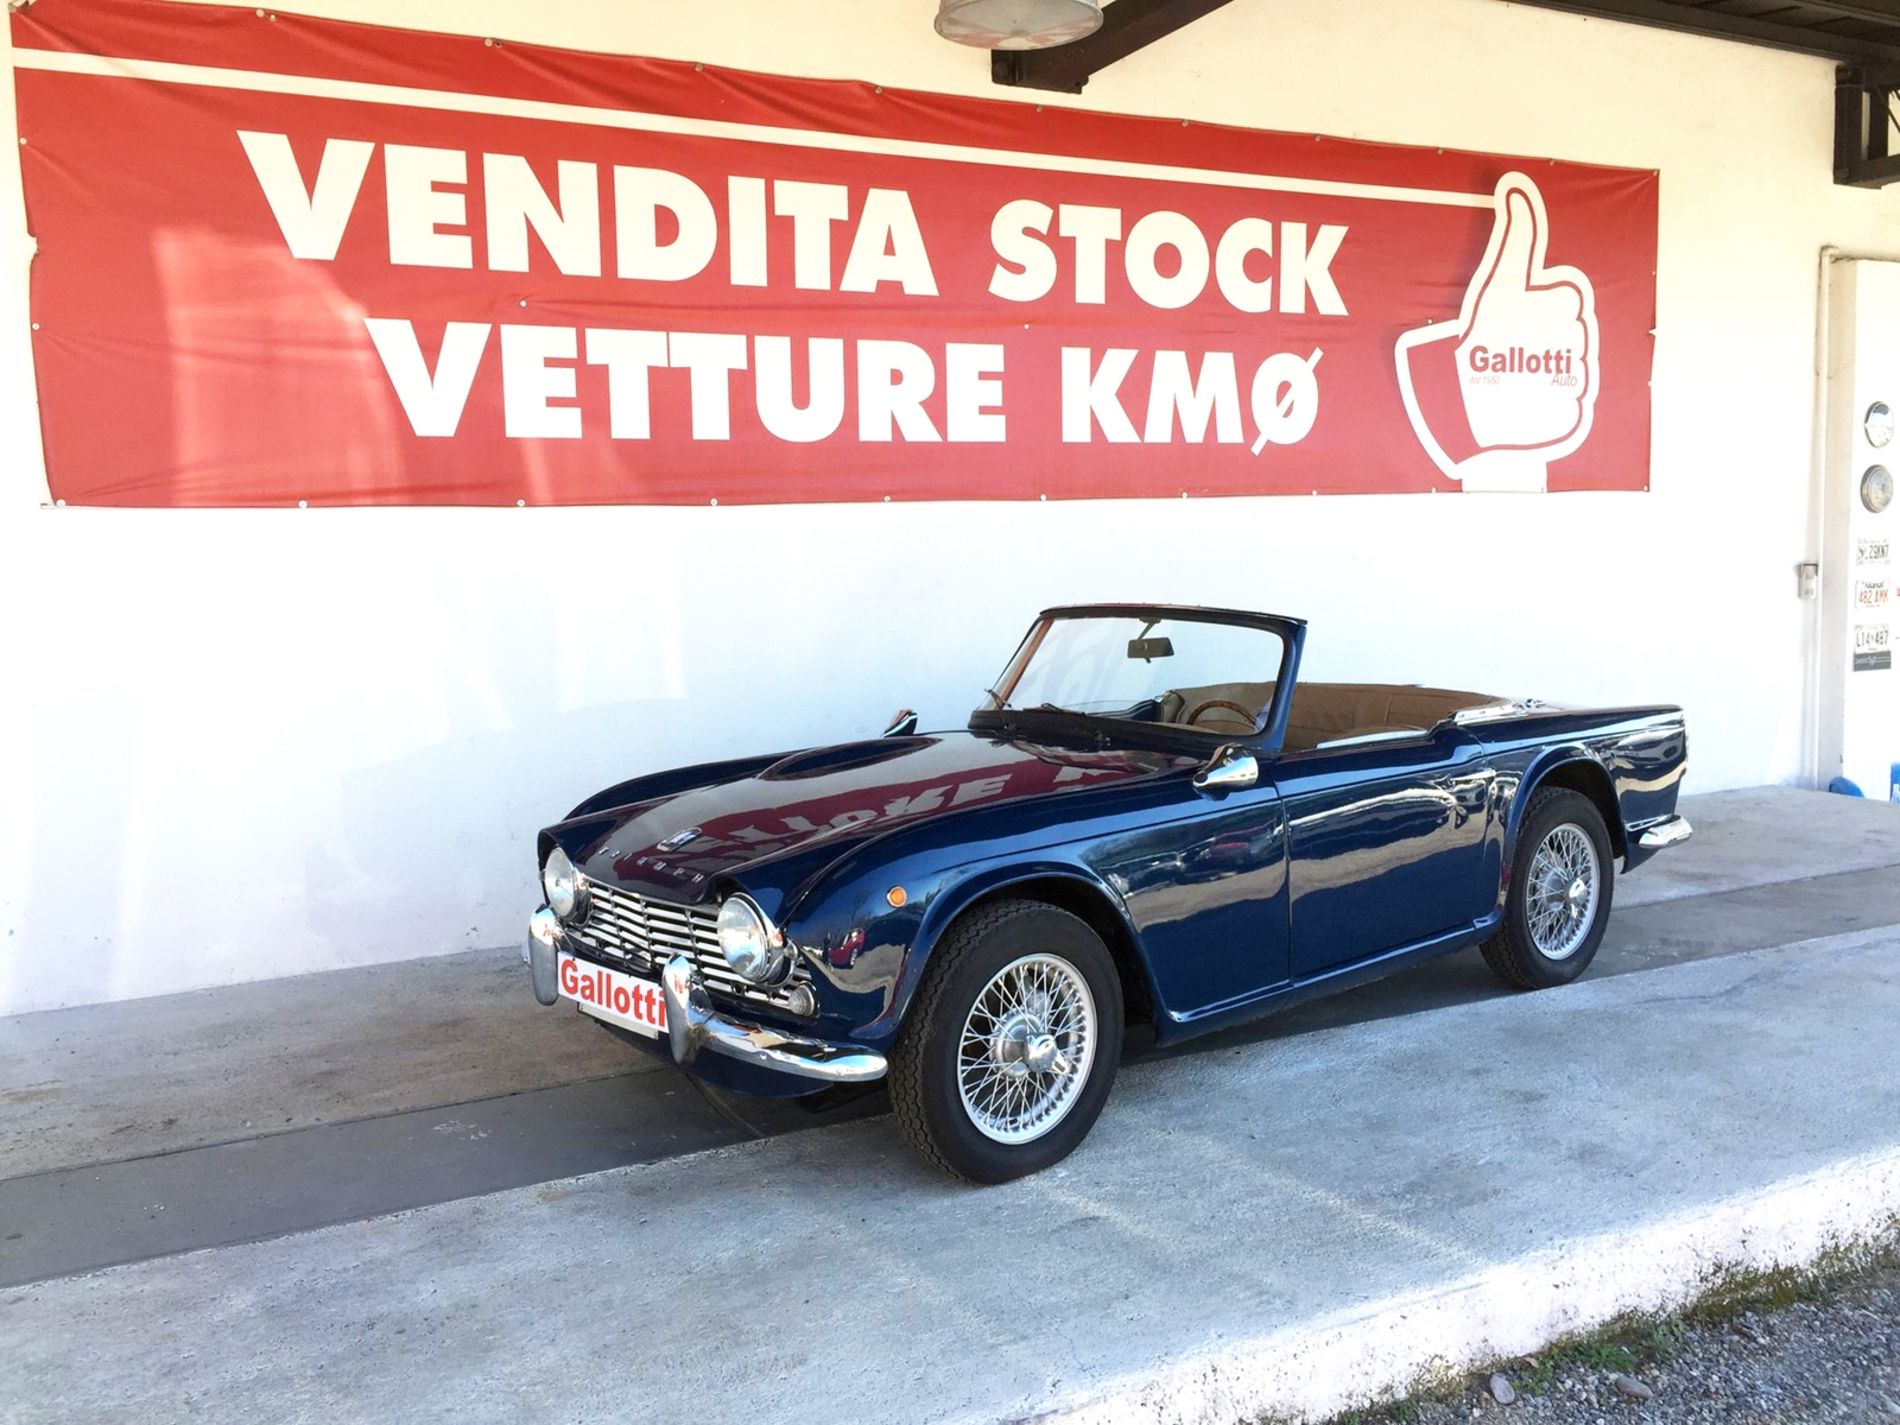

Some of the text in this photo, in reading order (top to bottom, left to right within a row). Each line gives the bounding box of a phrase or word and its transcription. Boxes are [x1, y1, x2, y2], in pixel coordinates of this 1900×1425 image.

[236, 129, 1350, 316] VENDITA STOCK
[362, 316, 1007, 443] VETTURE
[1468, 344, 1573, 374] Gallotti
[1550, 372, 1578, 388] Auto
[560, 958, 667, 1028] Gallotti
